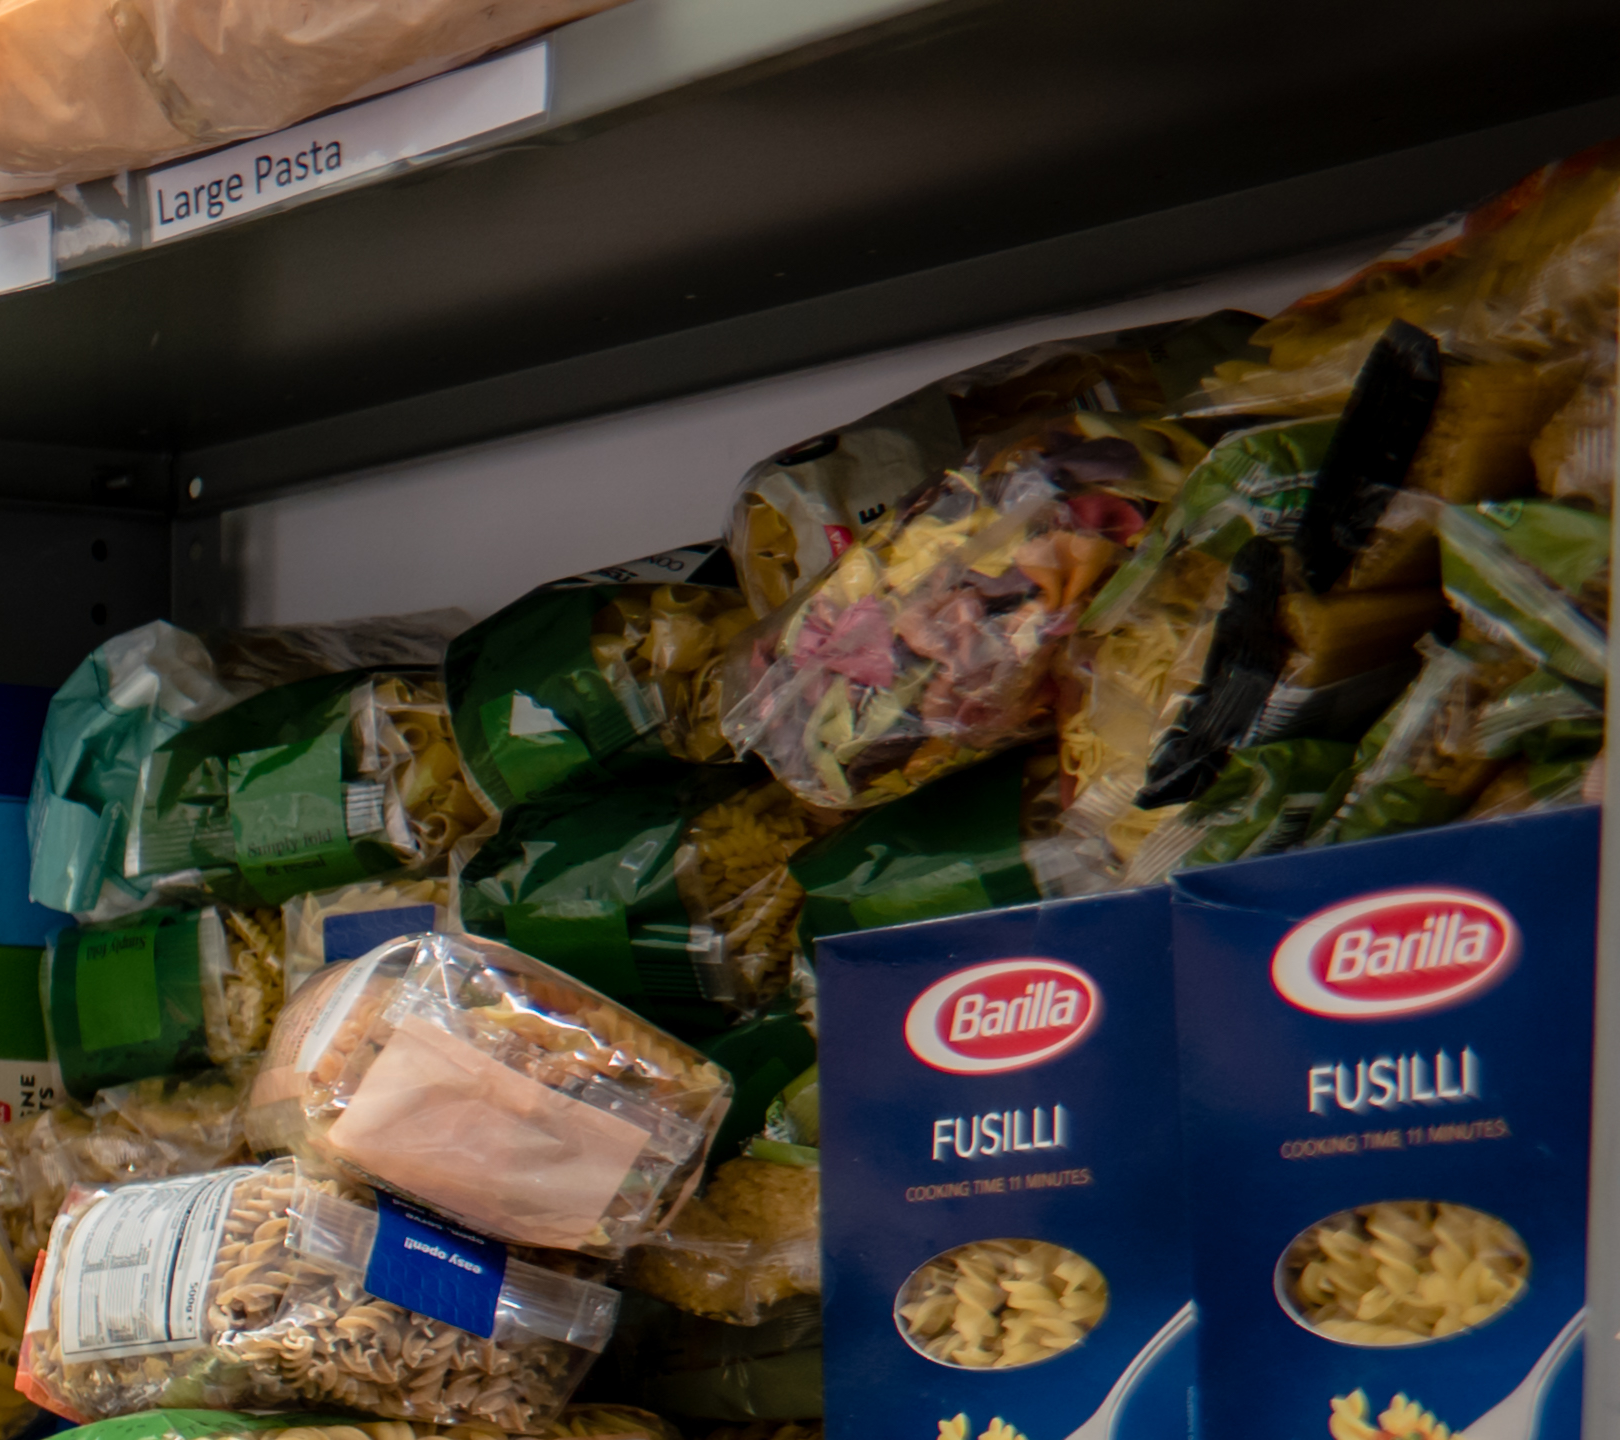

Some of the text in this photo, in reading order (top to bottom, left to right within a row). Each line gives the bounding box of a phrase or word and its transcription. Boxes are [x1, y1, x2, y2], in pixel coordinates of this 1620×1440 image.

[156, 138, 344, 226] Large Pasta
[1326, 913, 1490, 984] Barilla
[949, 982, 1081, 1043] Barilla
[1308, 1046, 1480, 1113] FUSILLI
[932, 1104, 1067, 1161] FUSILLI
[1280, 1118, 1508, 1160] COOKING TIME 11 MINUTES
[905, 1168, 1091, 1204] COOKING TIME 11 MINUTES
[448, 1250, 483, 1274] easy
